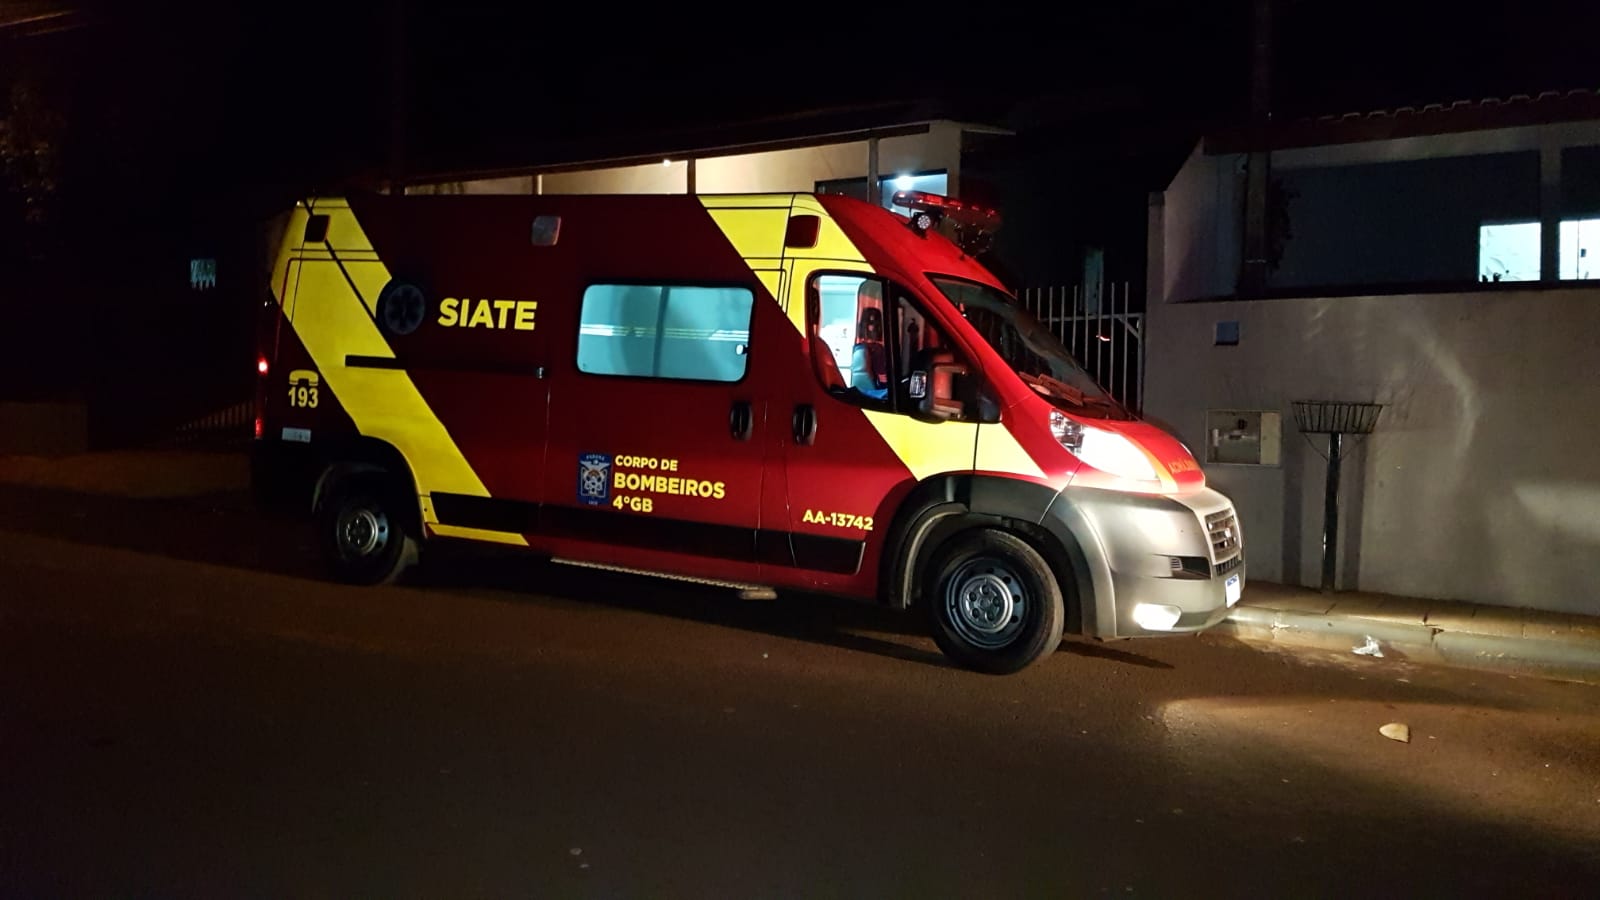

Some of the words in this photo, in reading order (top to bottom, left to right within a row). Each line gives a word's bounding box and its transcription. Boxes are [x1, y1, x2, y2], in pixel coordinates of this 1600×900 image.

[438, 298, 537, 330] SIATE
[288, 387, 318, 408] 193
[615, 455, 657, 470] CORPO
[661, 457, 678, 471] DE
[614, 472, 725, 499] BOMBEIROS
[803, 509, 874, 530] AA-13742
